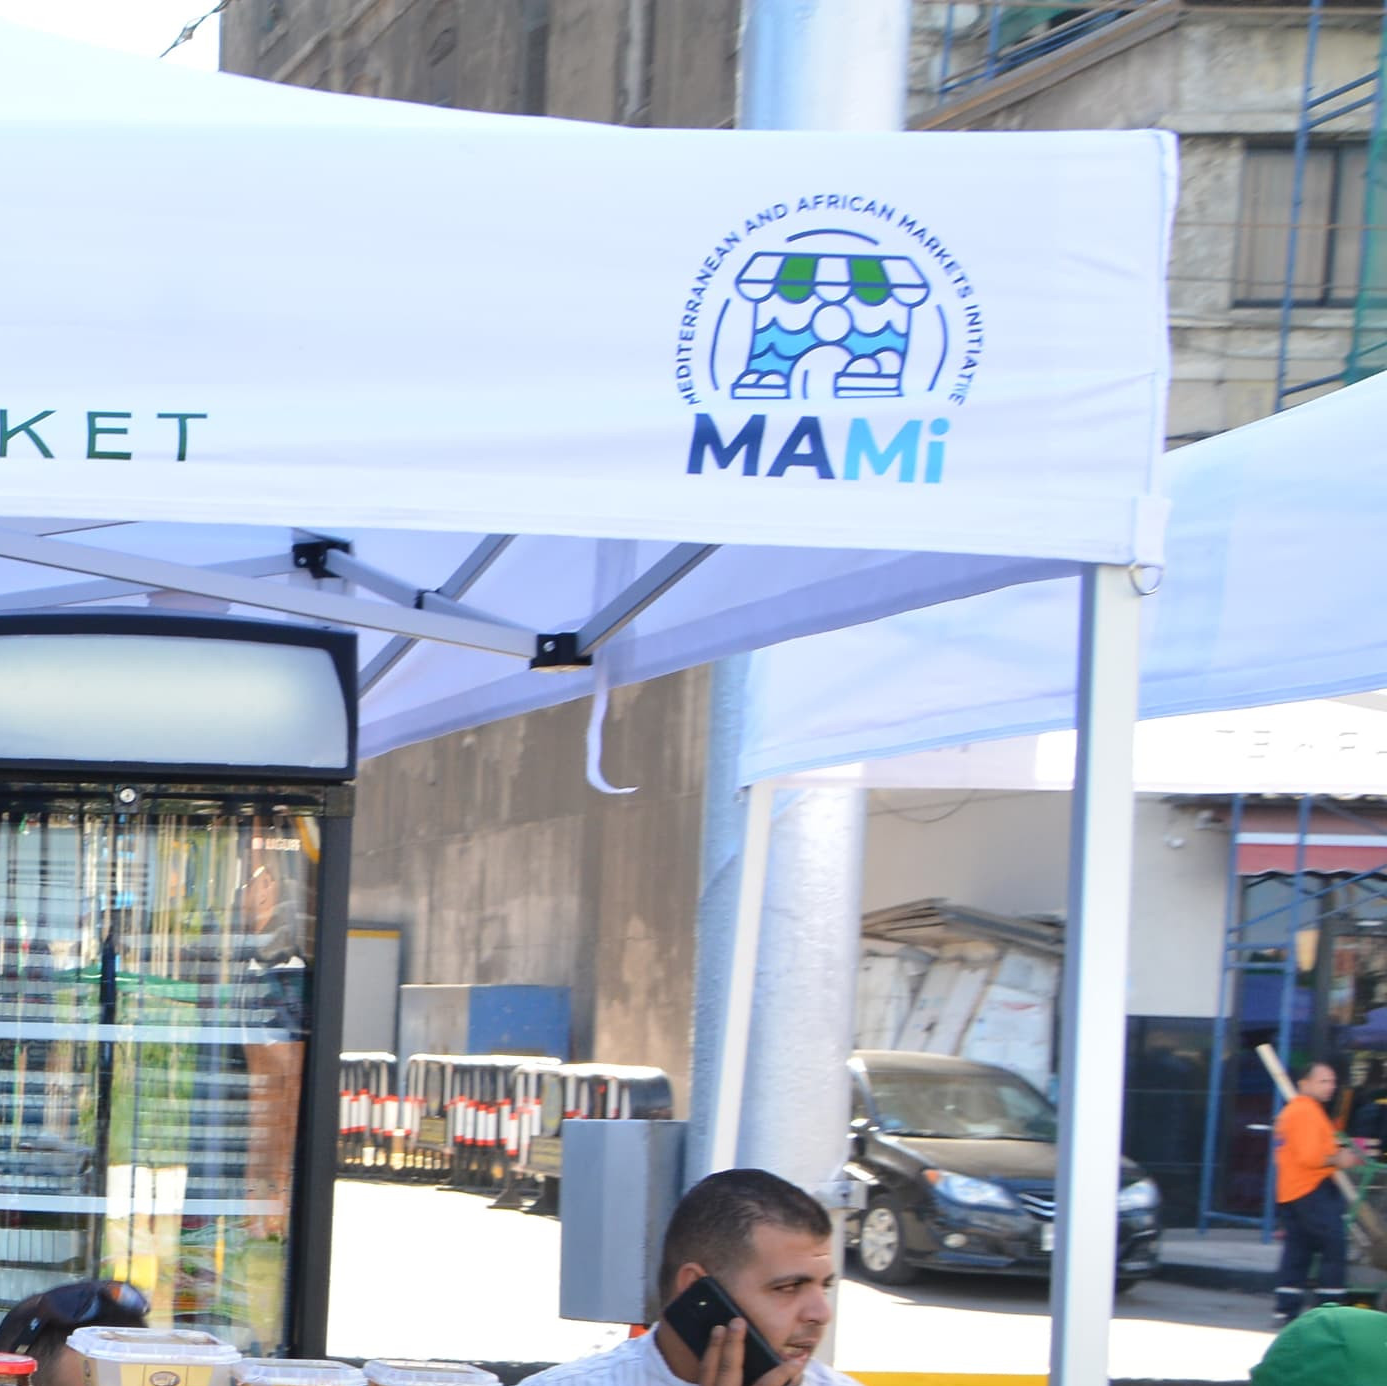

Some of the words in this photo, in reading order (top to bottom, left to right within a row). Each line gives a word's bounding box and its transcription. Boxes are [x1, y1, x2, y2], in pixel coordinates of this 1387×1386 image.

[675, 231, 741, 406] MEDITERRANEAN
[745, 203, 789, 234] AND
[796, 194, 896, 222] AFRICAN
[897, 214, 975, 299] MARKETS
[948, 304, 985, 406] INITIATIVE
